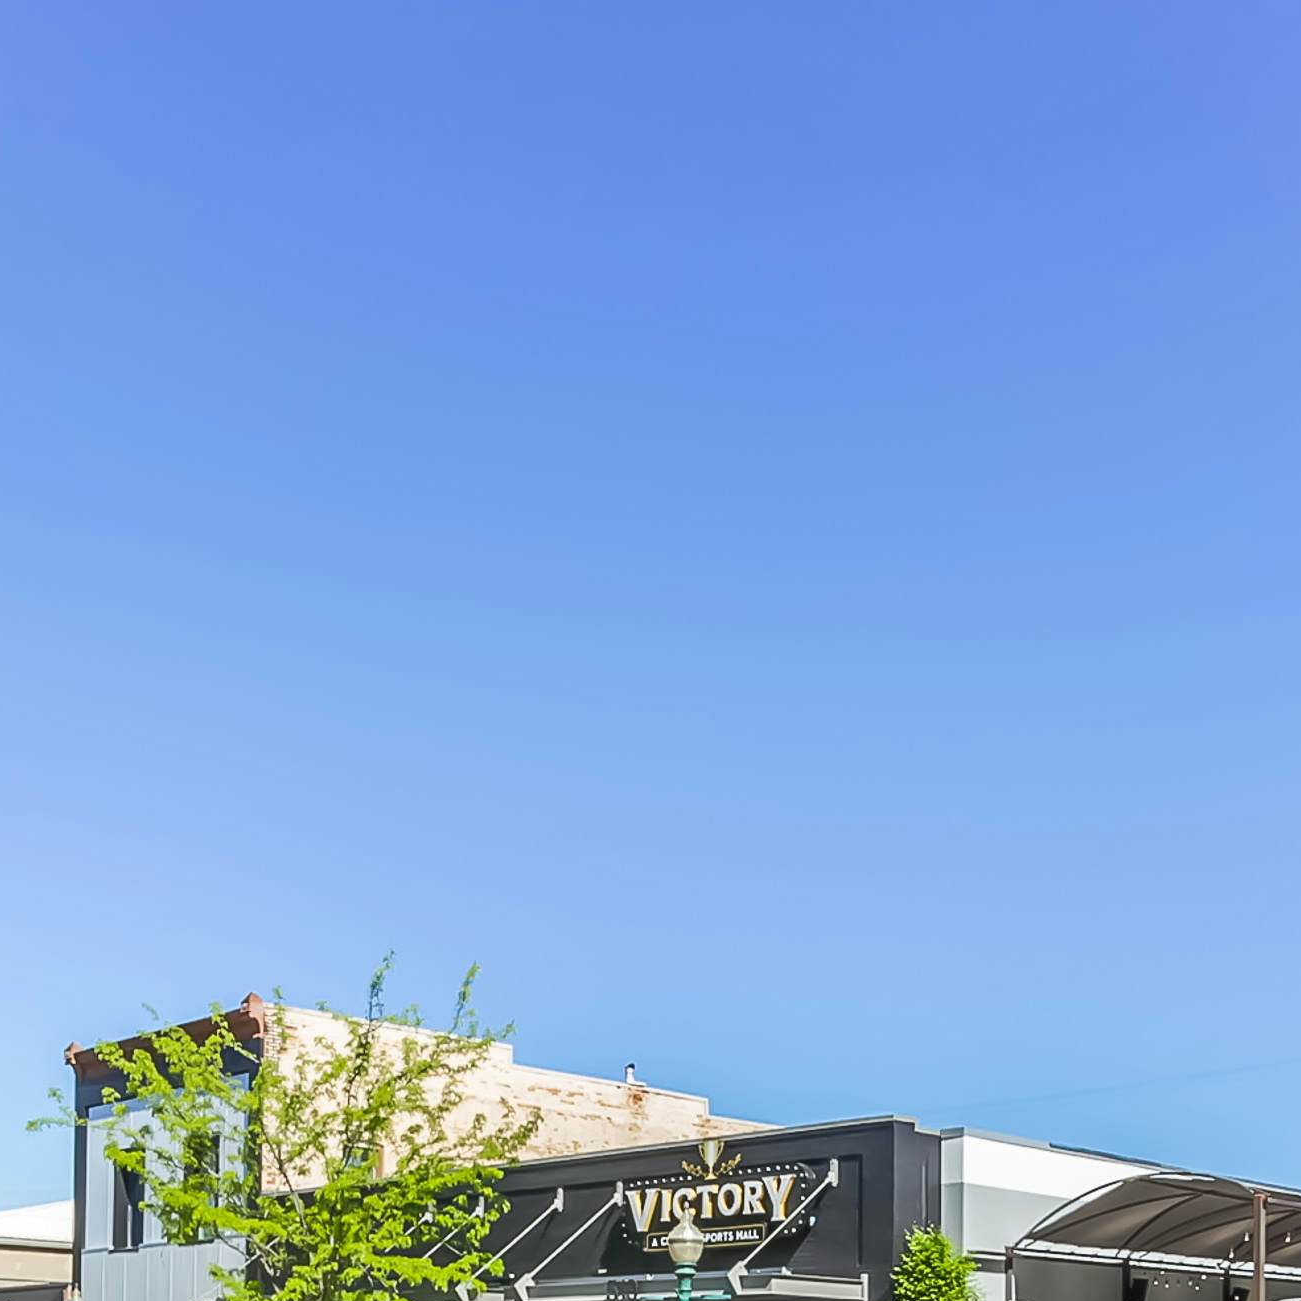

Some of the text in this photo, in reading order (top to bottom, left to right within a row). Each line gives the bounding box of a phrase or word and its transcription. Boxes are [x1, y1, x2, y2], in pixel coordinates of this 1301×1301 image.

[625, 1173, 797, 1232] VICTORY
[651, 1238, 659, 1247] A
[736, 1229, 759, 1241] HALL
